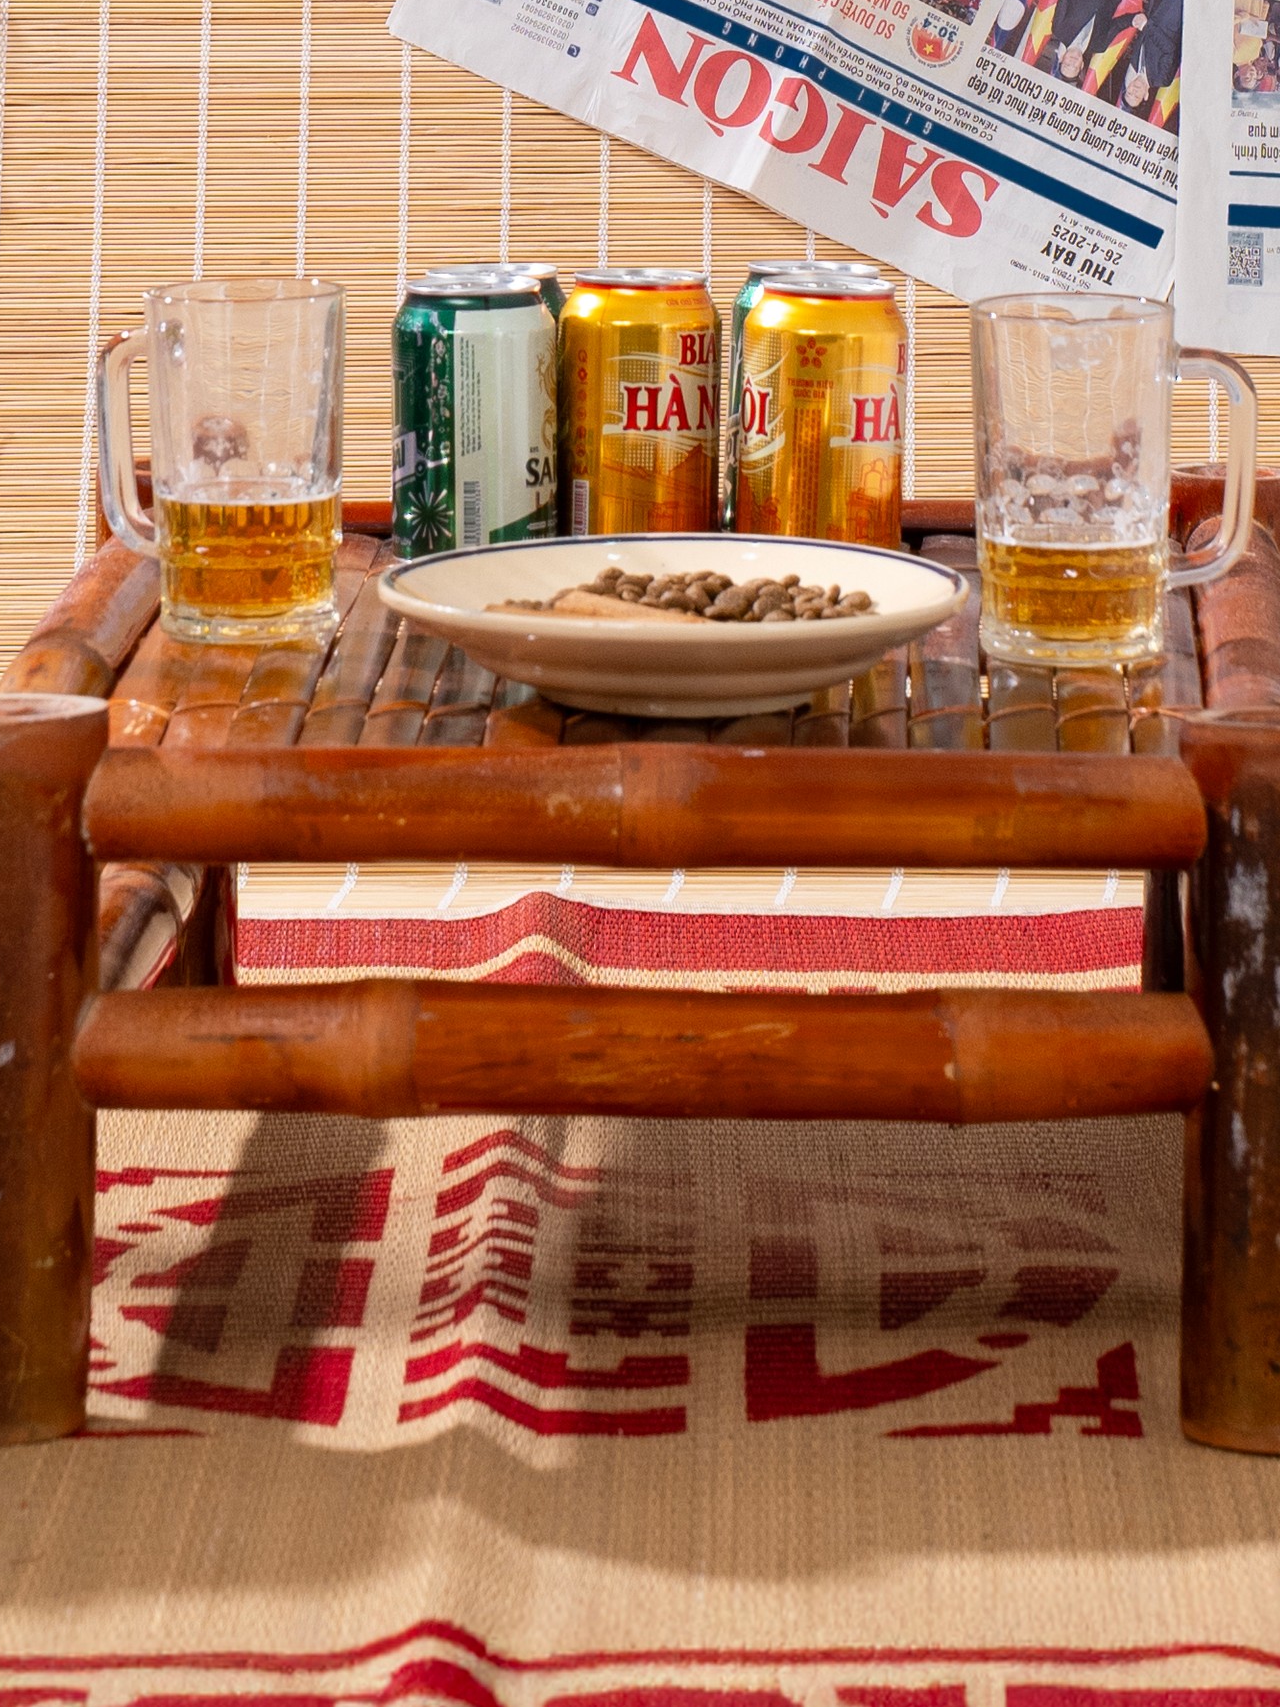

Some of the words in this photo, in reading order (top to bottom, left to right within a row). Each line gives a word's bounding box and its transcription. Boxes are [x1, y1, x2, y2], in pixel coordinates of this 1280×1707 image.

[1040, 240, 1076, 266] BẢY
[1077, 258, 1114, 285] THỨ
[741, 376, 770, 445] ỘI
